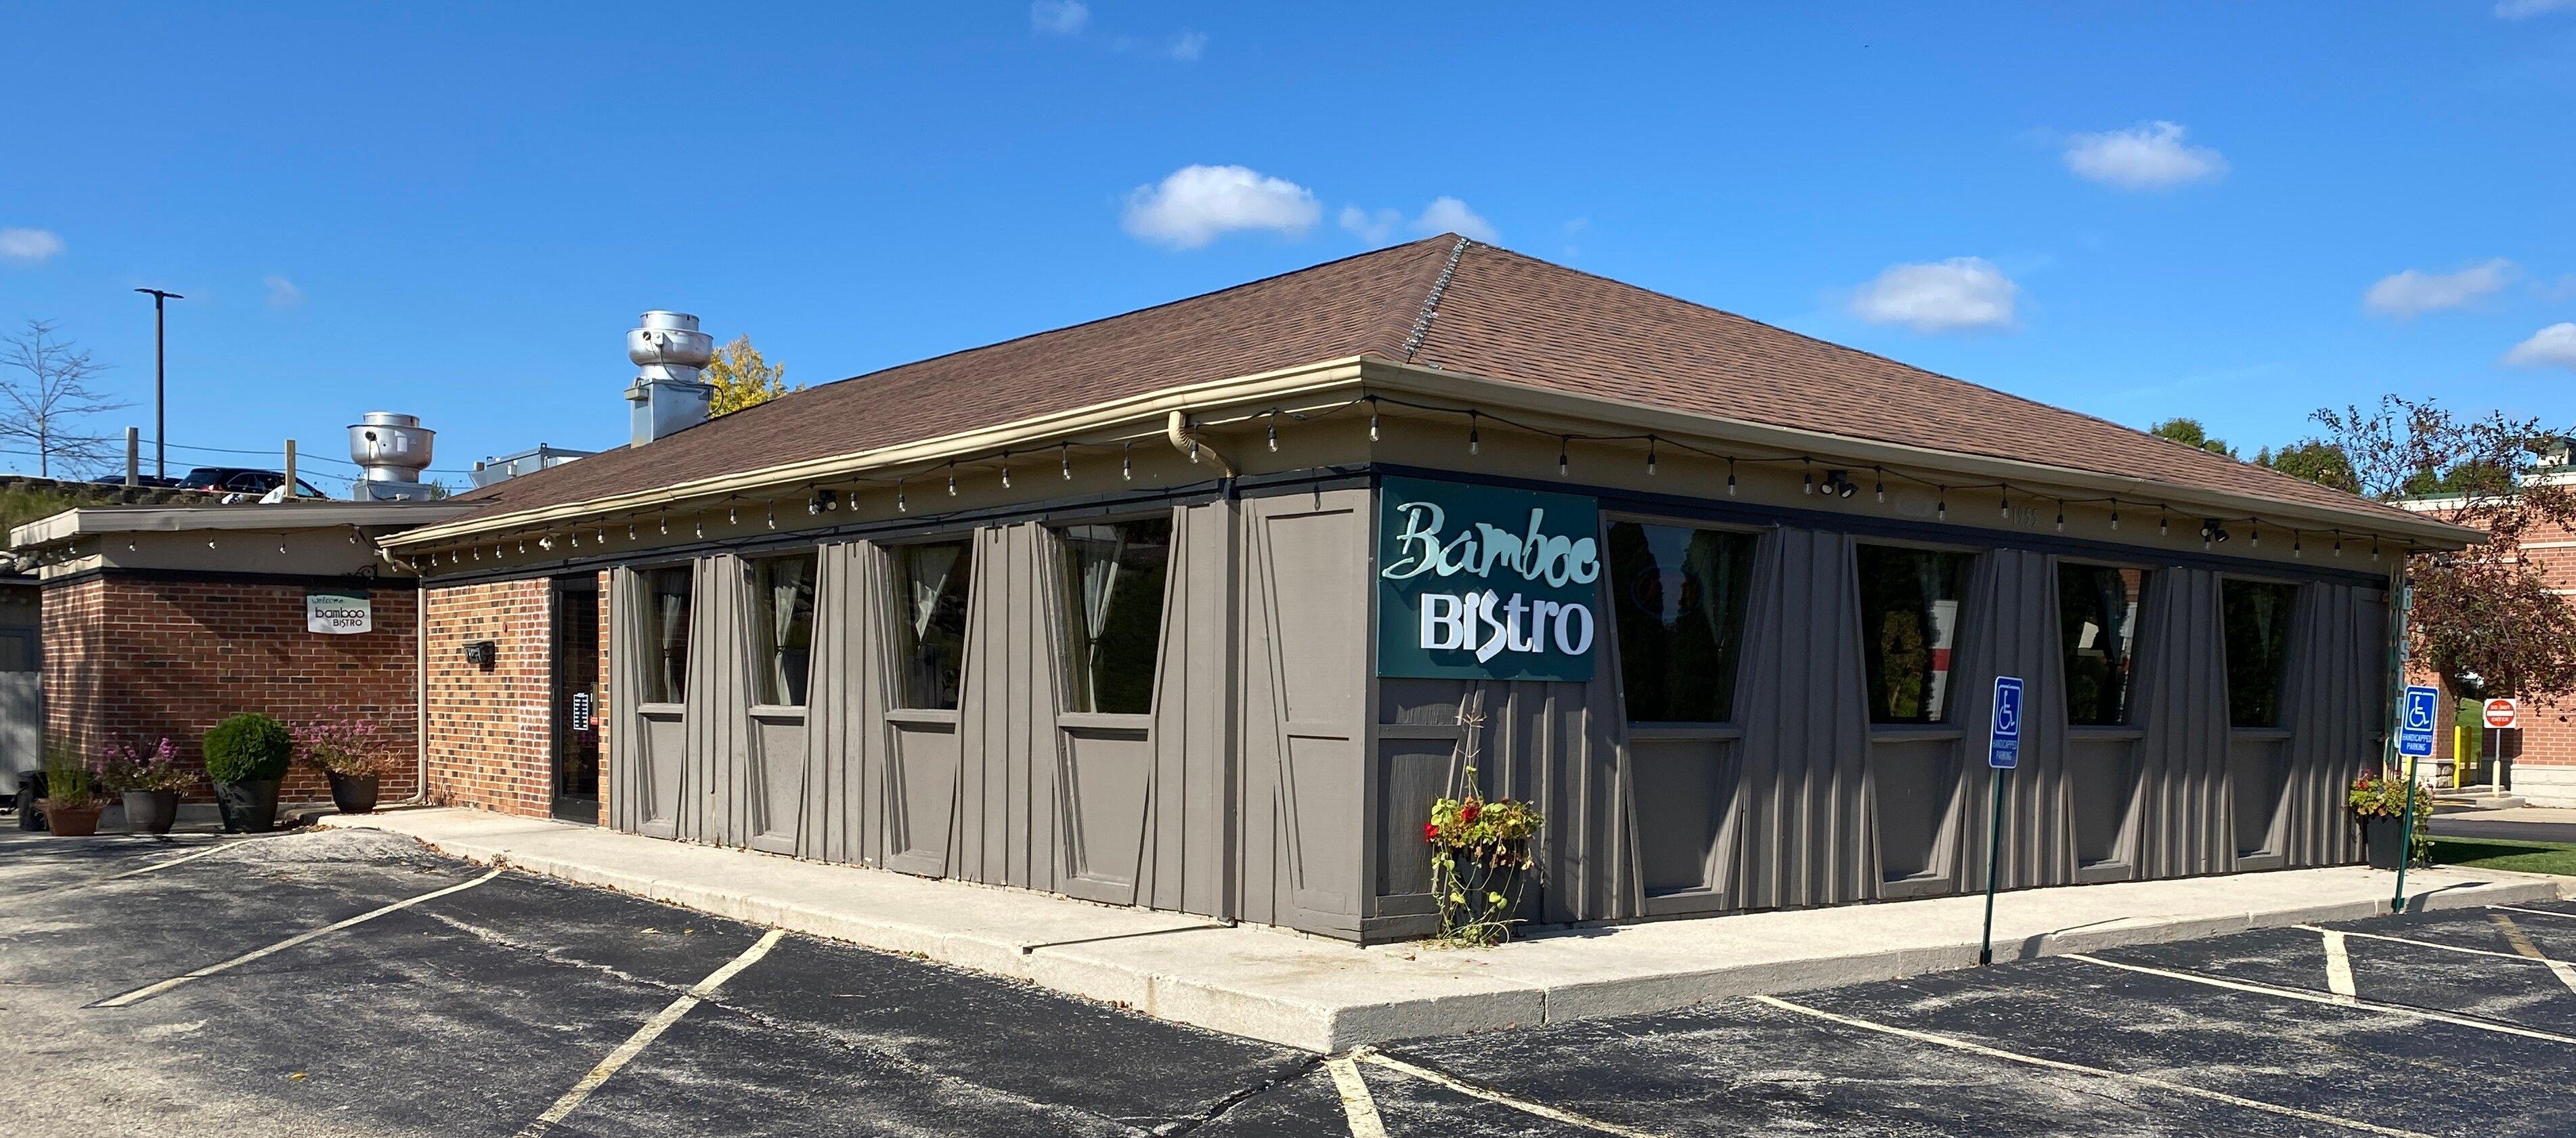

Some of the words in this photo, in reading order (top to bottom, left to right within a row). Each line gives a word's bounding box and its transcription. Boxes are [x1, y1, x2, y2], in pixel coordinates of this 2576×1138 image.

[1382, 502, 1600, 588] Bamboo
[315, 607, 365, 618] bamboo
[333, 619, 362, 628] BISTRO
[2402, 734, 2432, 743] HANDICAPPED
[2407, 743, 2426, 751] PARKING
